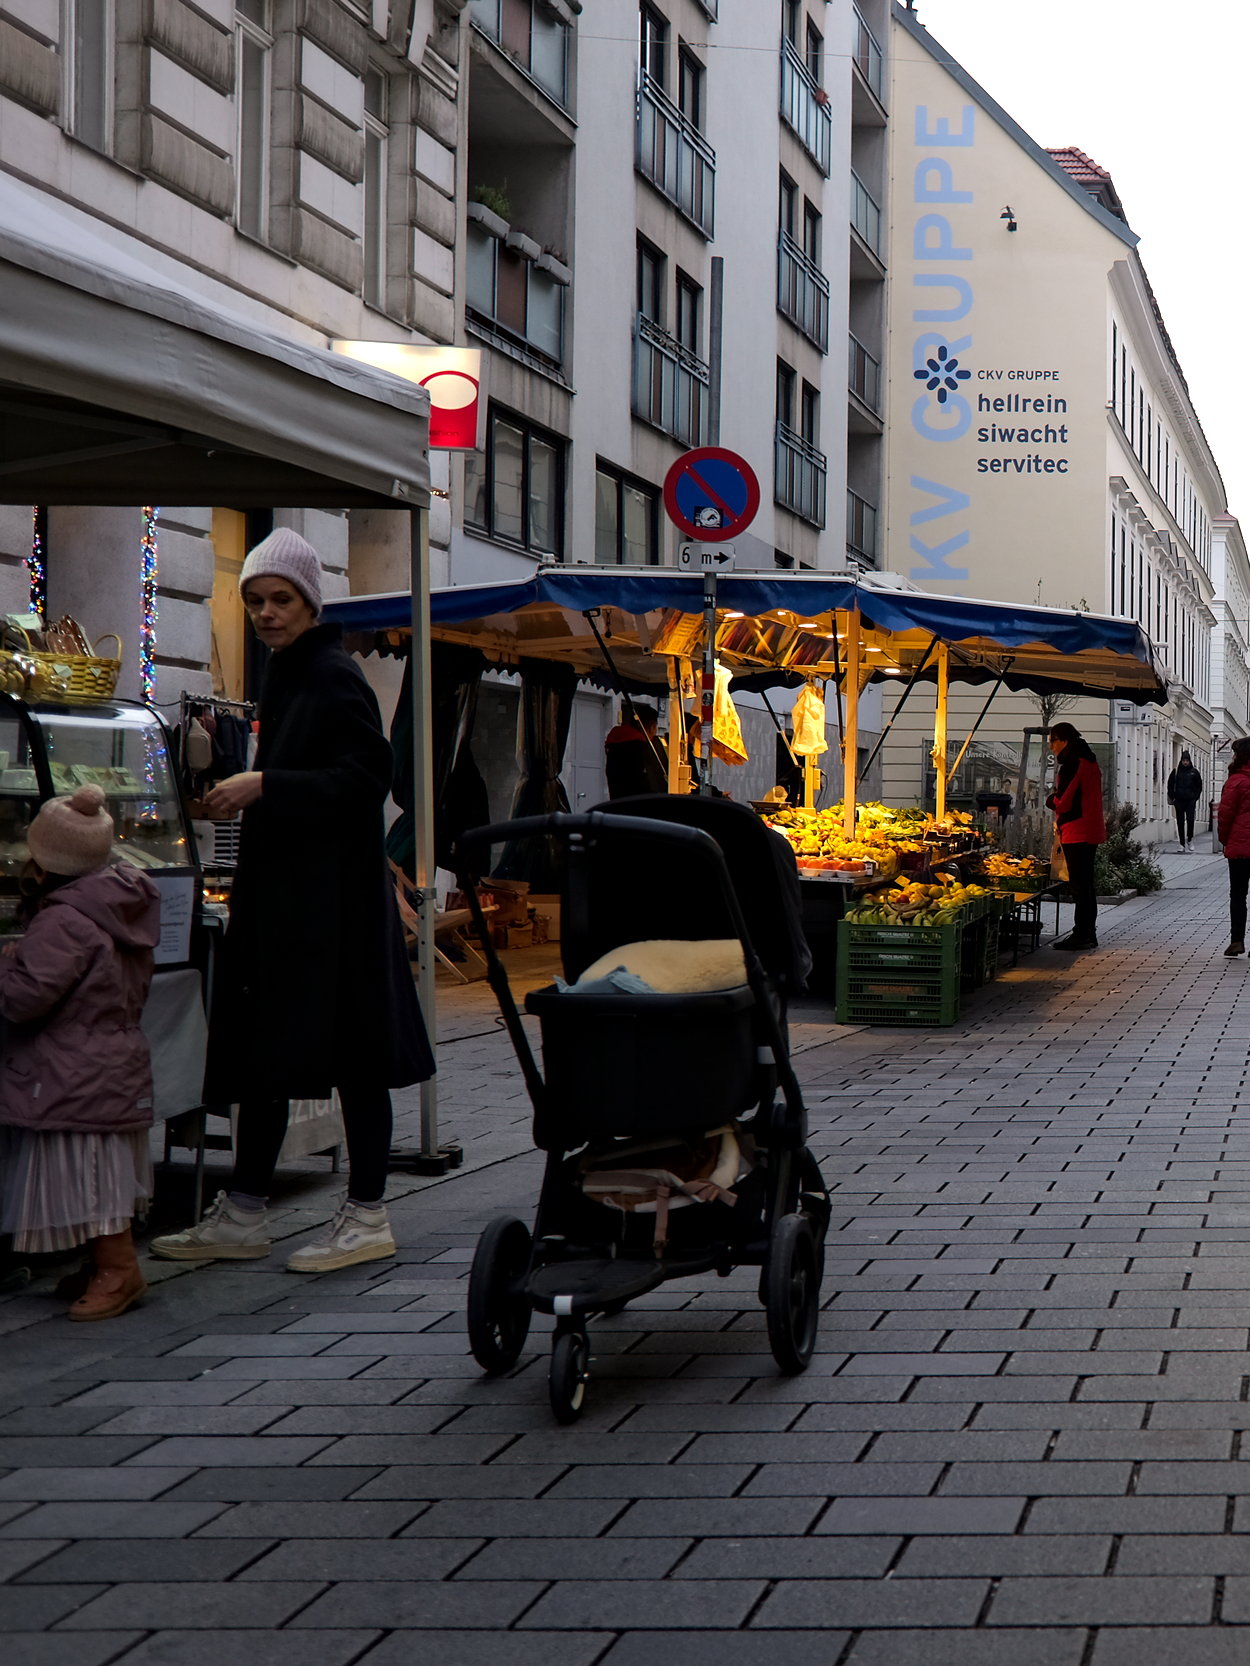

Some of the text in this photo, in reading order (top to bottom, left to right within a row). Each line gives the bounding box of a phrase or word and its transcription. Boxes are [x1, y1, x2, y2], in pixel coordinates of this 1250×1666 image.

[909, 104, 975, 592] KV GRUPPE
[977, 370, 1060, 381] CKV GRUPPE
[978, 393, 1067, 413] hellrein
[977, 423, 1068, 443] siwacht
[977, 454, 1069, 473] servitec
[682, 546, 712, 564] 6 m
[993, 750, 1023, 759] Kontroll
